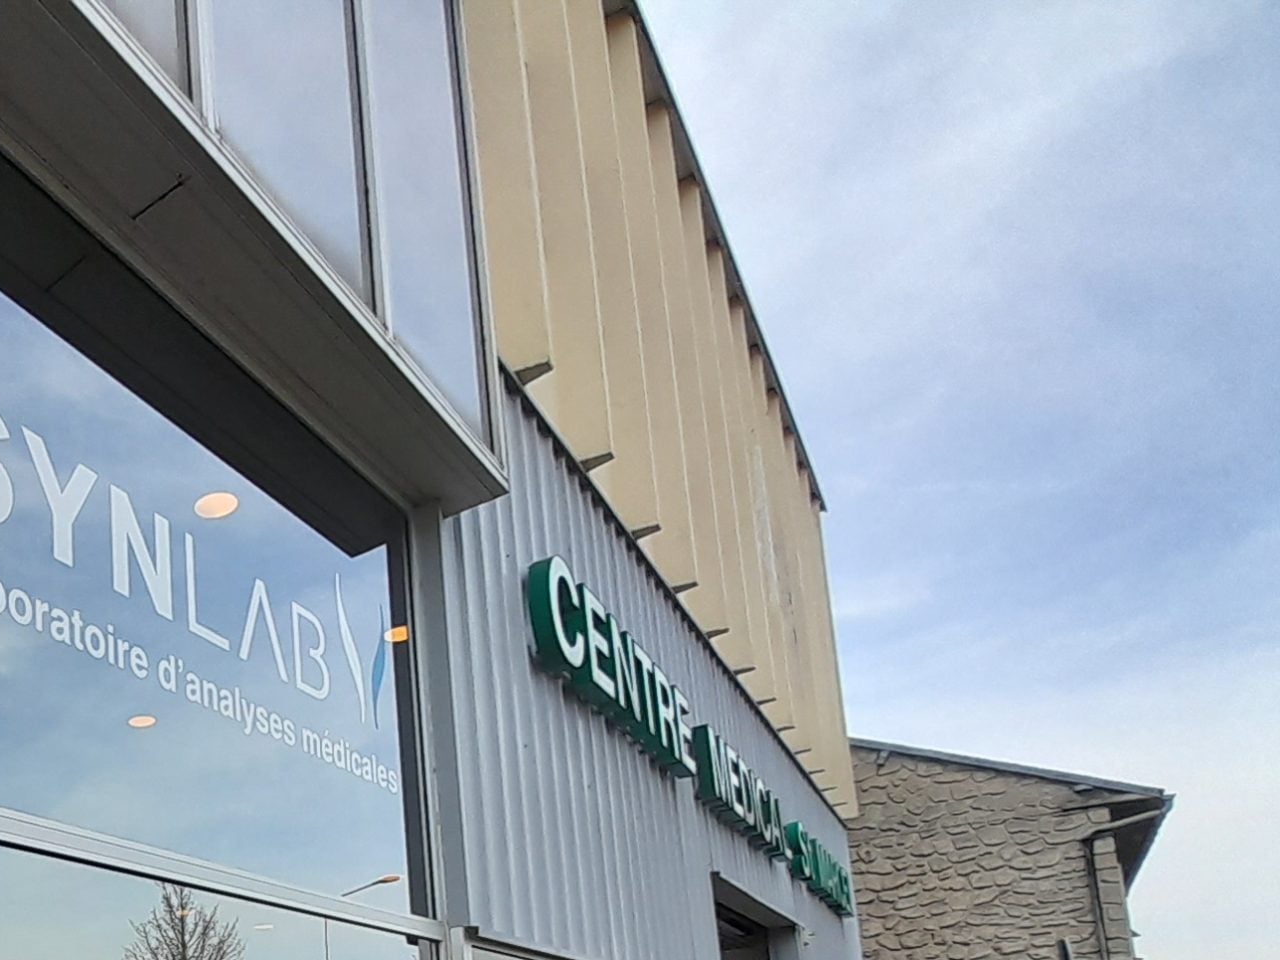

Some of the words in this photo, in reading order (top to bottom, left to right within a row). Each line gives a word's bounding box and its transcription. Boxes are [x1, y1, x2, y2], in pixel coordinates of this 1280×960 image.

[157, 654, 297, 747] d'analyses
[301, 727, 399, 795] médicales
[545, 555, 698, 776] CENTRE
